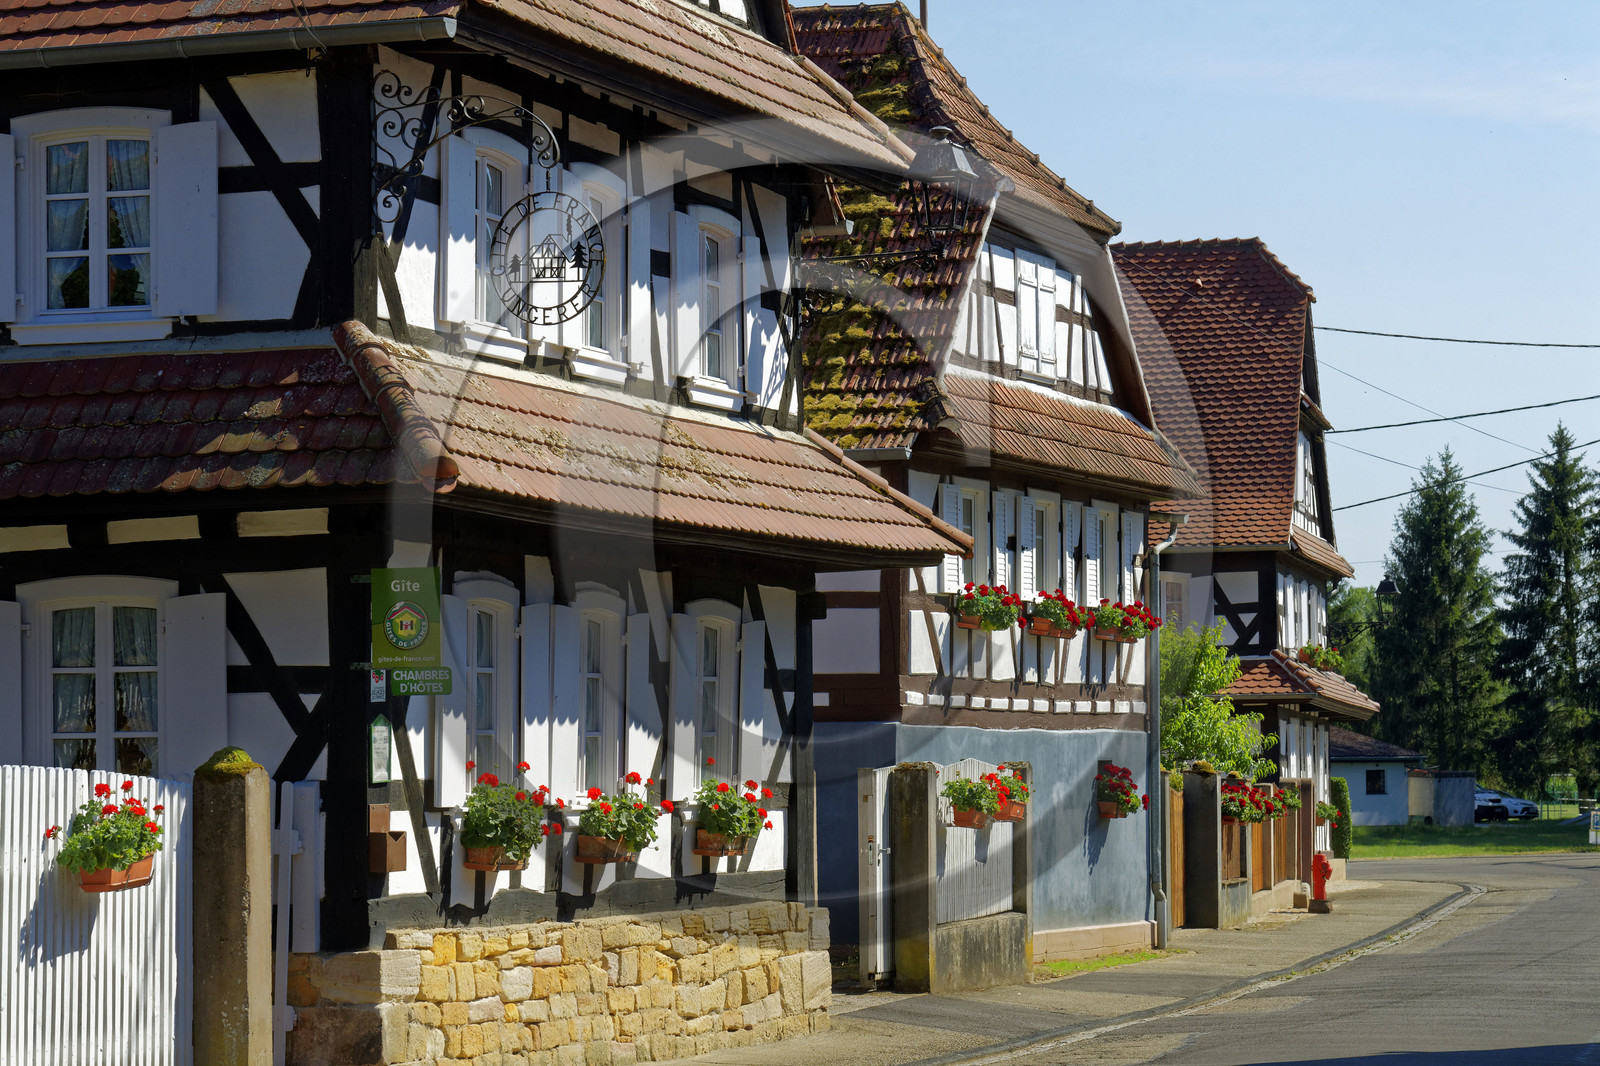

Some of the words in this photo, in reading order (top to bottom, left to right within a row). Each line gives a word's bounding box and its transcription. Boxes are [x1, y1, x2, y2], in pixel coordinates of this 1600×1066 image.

[515, 194, 543, 218] DE
[554, 192, 605, 267] FRANCE
[502, 284, 597, 325] UNGERER
[390, 580, 420, 592] Gîte
[398, 640, 408, 648] DE
[410, 621, 427, 646] FRANCE
[393, 670, 450, 681] CHAMBRES
